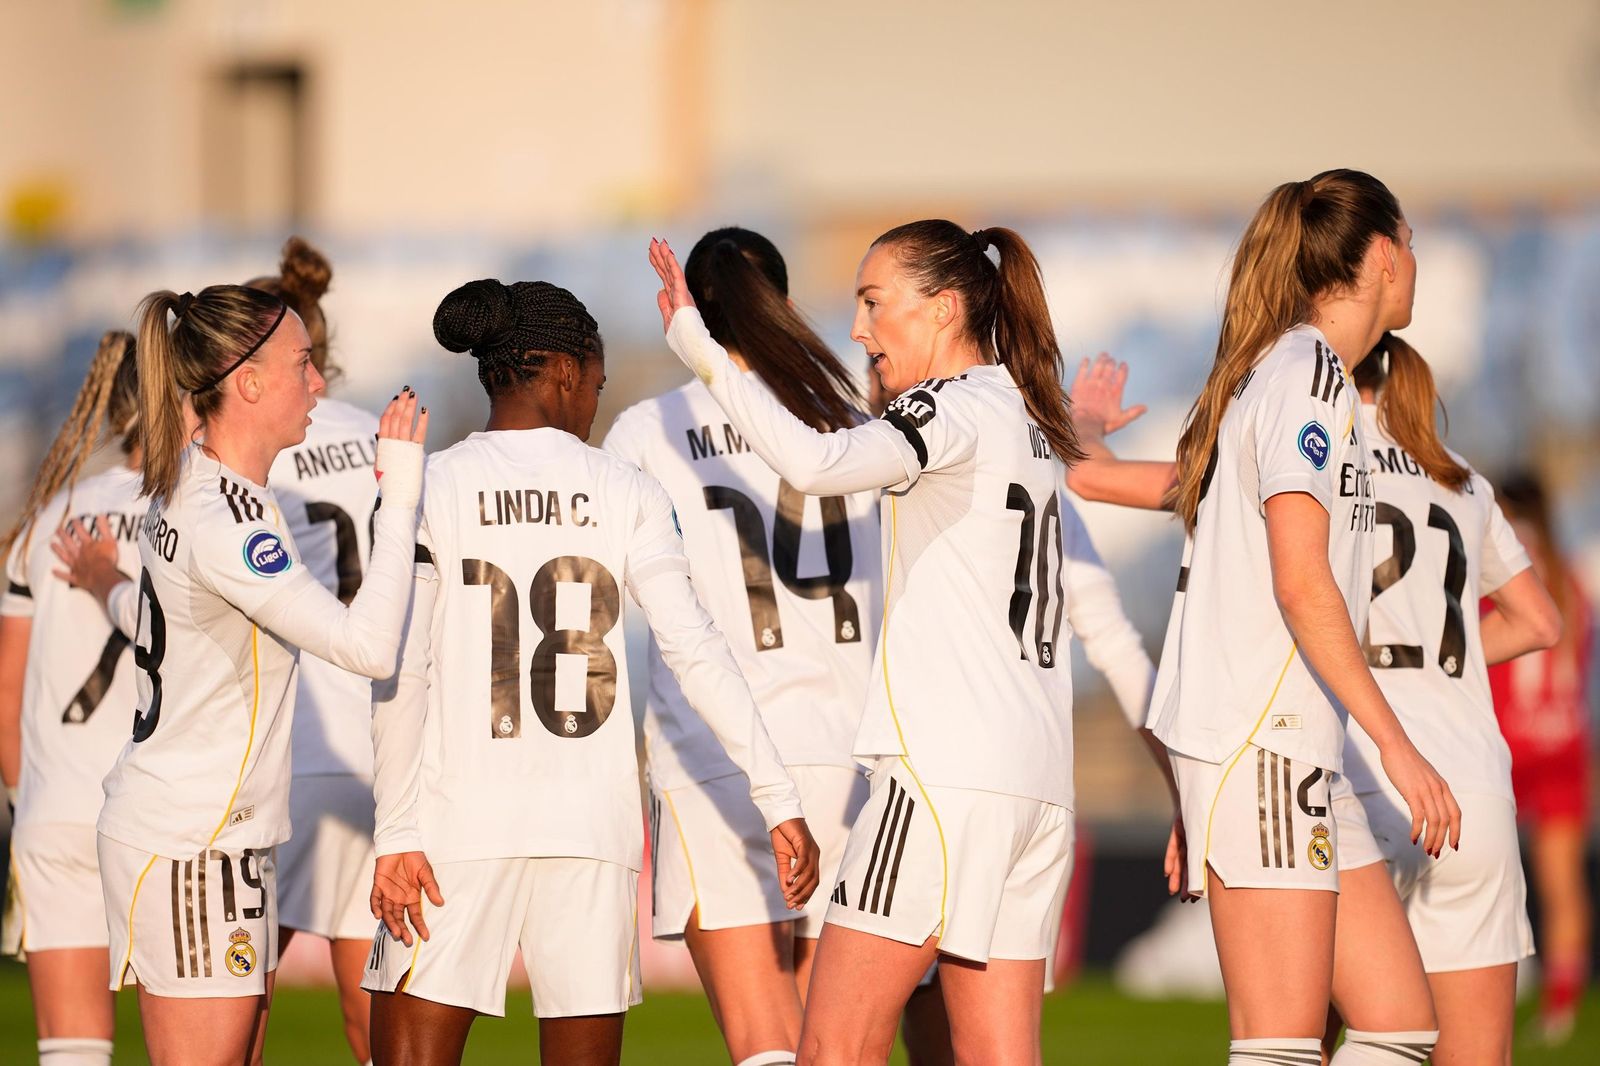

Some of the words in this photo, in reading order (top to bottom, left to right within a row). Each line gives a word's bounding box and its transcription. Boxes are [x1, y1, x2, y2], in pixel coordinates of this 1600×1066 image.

[293, 438, 377, 481] ANGEL
[686, 423, 751, 461] M.M
[478, 489, 562, 526] LINDA
[571, 492, 597, 527] C.
[259, 551, 279, 566] Liga
[277, 548, 284, 557] F
[703, 476, 861, 652] 14
[1006, 482, 1064, 669] 10
[1370, 502, 1467, 678] 21
[462, 555, 620, 738] 18
[210, 848, 266, 922] 19
